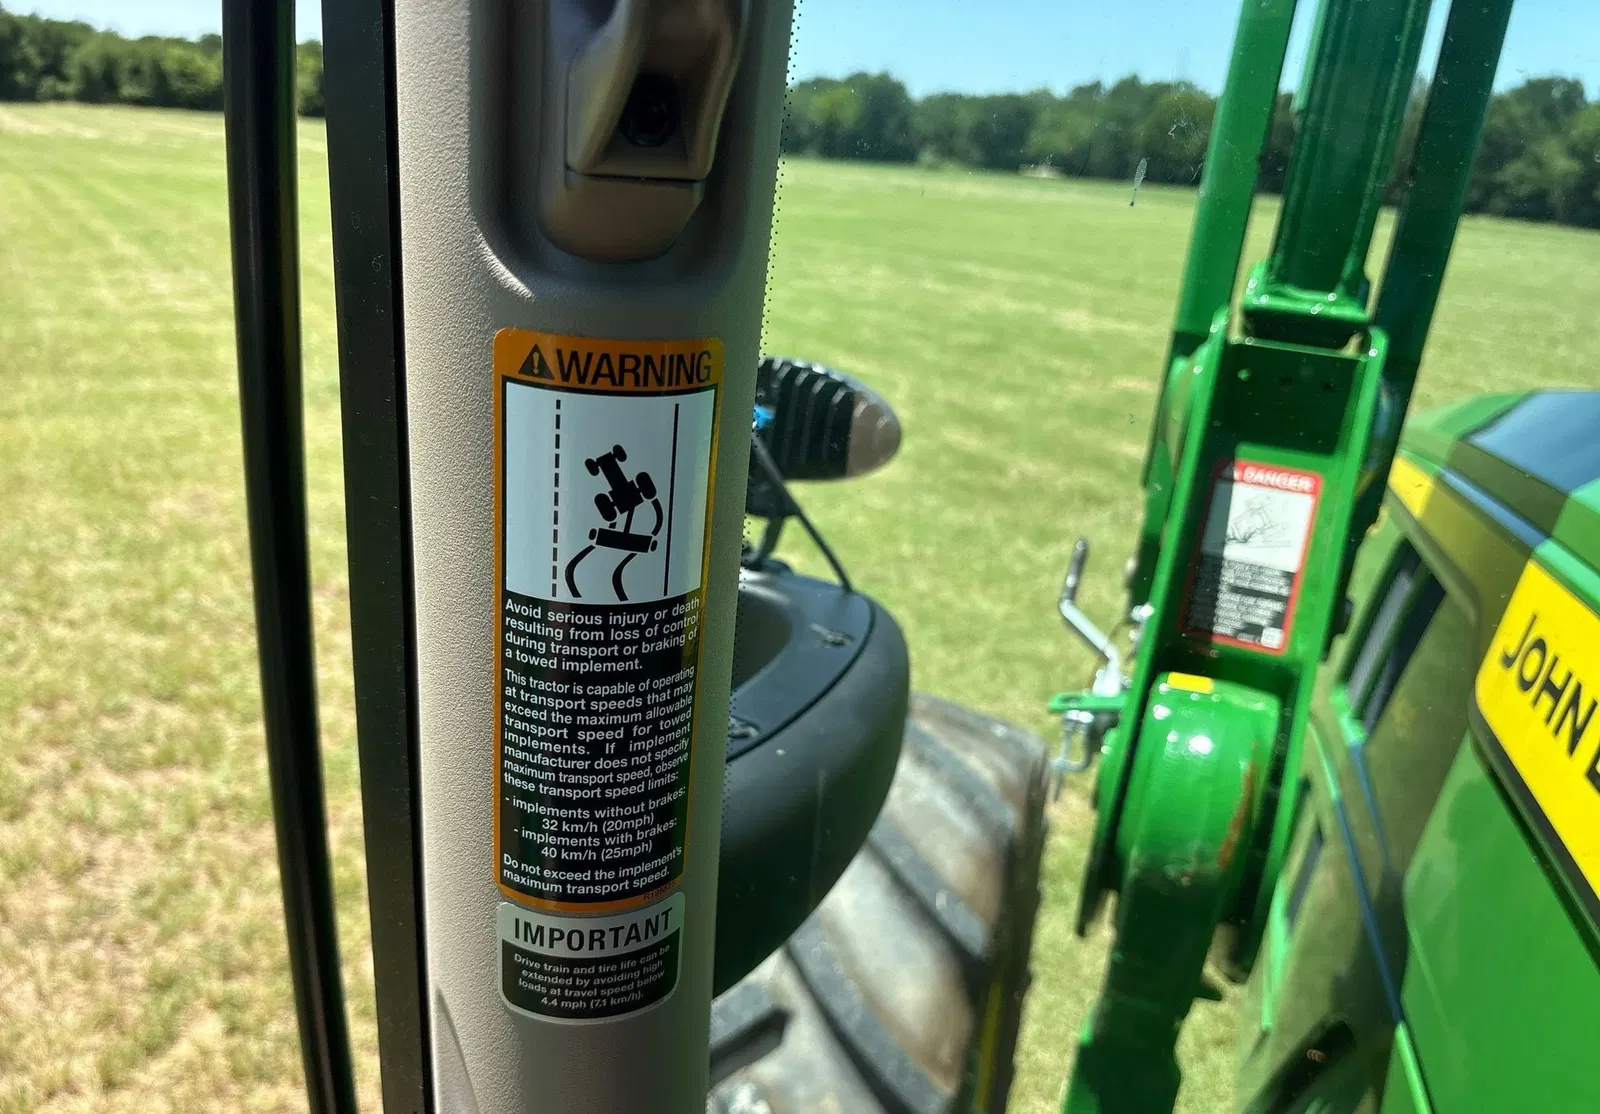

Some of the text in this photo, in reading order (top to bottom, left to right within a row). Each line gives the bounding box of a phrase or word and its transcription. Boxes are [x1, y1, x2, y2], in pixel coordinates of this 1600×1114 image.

[556, 349, 712, 387] WARNING
[506, 597, 700, 627] Avoid serious injury or death
[506, 612, 699, 641] resulting from loss of control
[506, 627, 698, 659] during transport or braking of
[506, 649, 643, 675] a towed implement.
[505, 665, 695, 697] This tractor is capable of operating
[505, 680, 694, 713] at transport speeds that may
[1502, 611, 1599, 760] JOHN
[505, 694, 693, 726] exceed the maximum allowable
[505, 709, 692, 742] transport speed for towed
[504, 724, 691, 755] implements. If implement
[504, 737, 690, 770] manufacturer does not specify
[504, 752, 689, 787] maximum transport speed, observe
[504, 772, 679, 800] these transport speed limits:
[513, 796, 590, 819] implements
[595, 802, 645, 819] without
[649, 787, 686, 810] brakes:
[522, 827, 600, 847] implements
[605, 832, 632, 846] with
[636, 817, 678, 841] brakes:
[542, 813, 655, 834] 32 km/h (20mph)
[504, 845, 682, 881] Do not exceed the implement's
[541, 840, 653, 862] 40 km/h (25mph)
[504, 867, 670, 895] maximum transport speed.
[515, 907, 673, 952] IMPORTANT
[514, 945, 671, 974] Drive train and tire life can be
[522, 960, 664, 987] extended by avoiding high
[519, 970, 666, 997] loads at travel speed below
[561, 1000, 587, 1010] mph
